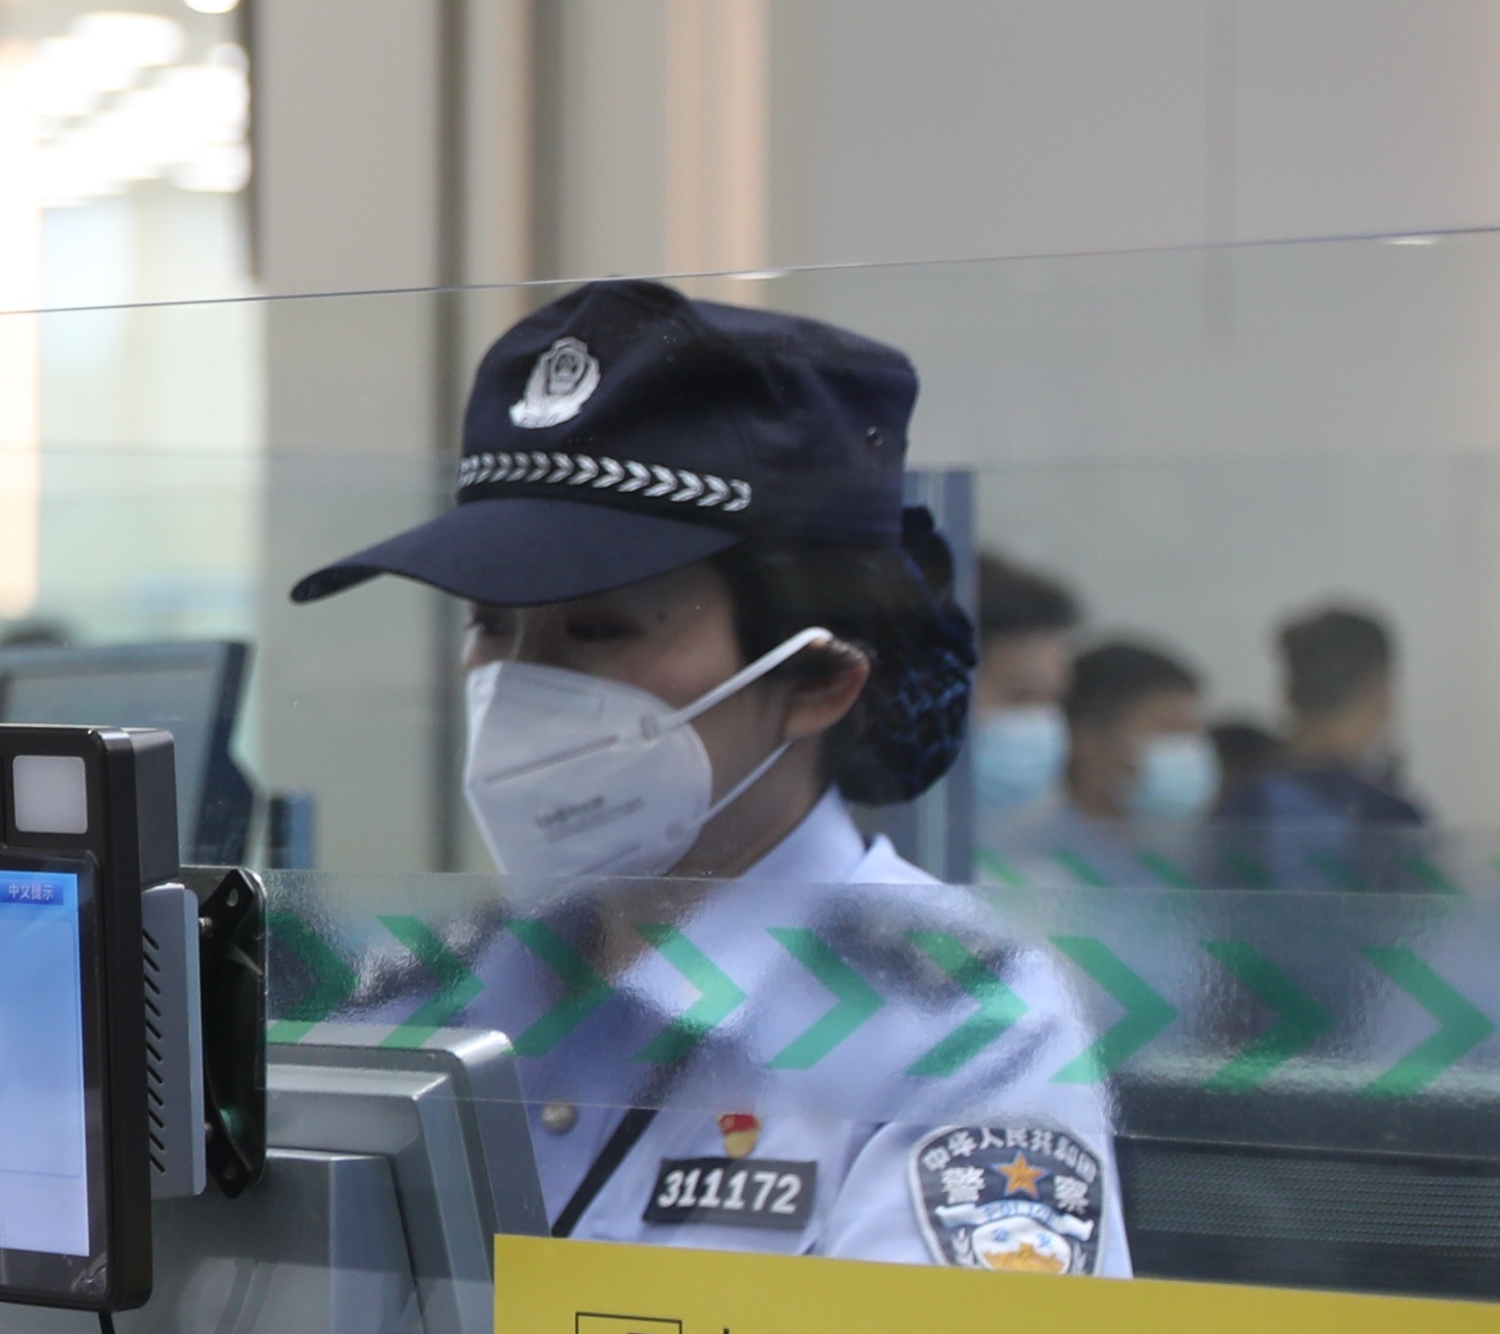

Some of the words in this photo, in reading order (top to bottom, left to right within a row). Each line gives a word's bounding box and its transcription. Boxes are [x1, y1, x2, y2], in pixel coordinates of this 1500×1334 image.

[8, 883, 54, 901] 中文提示
[657, 1168, 802, 1215] 311172
